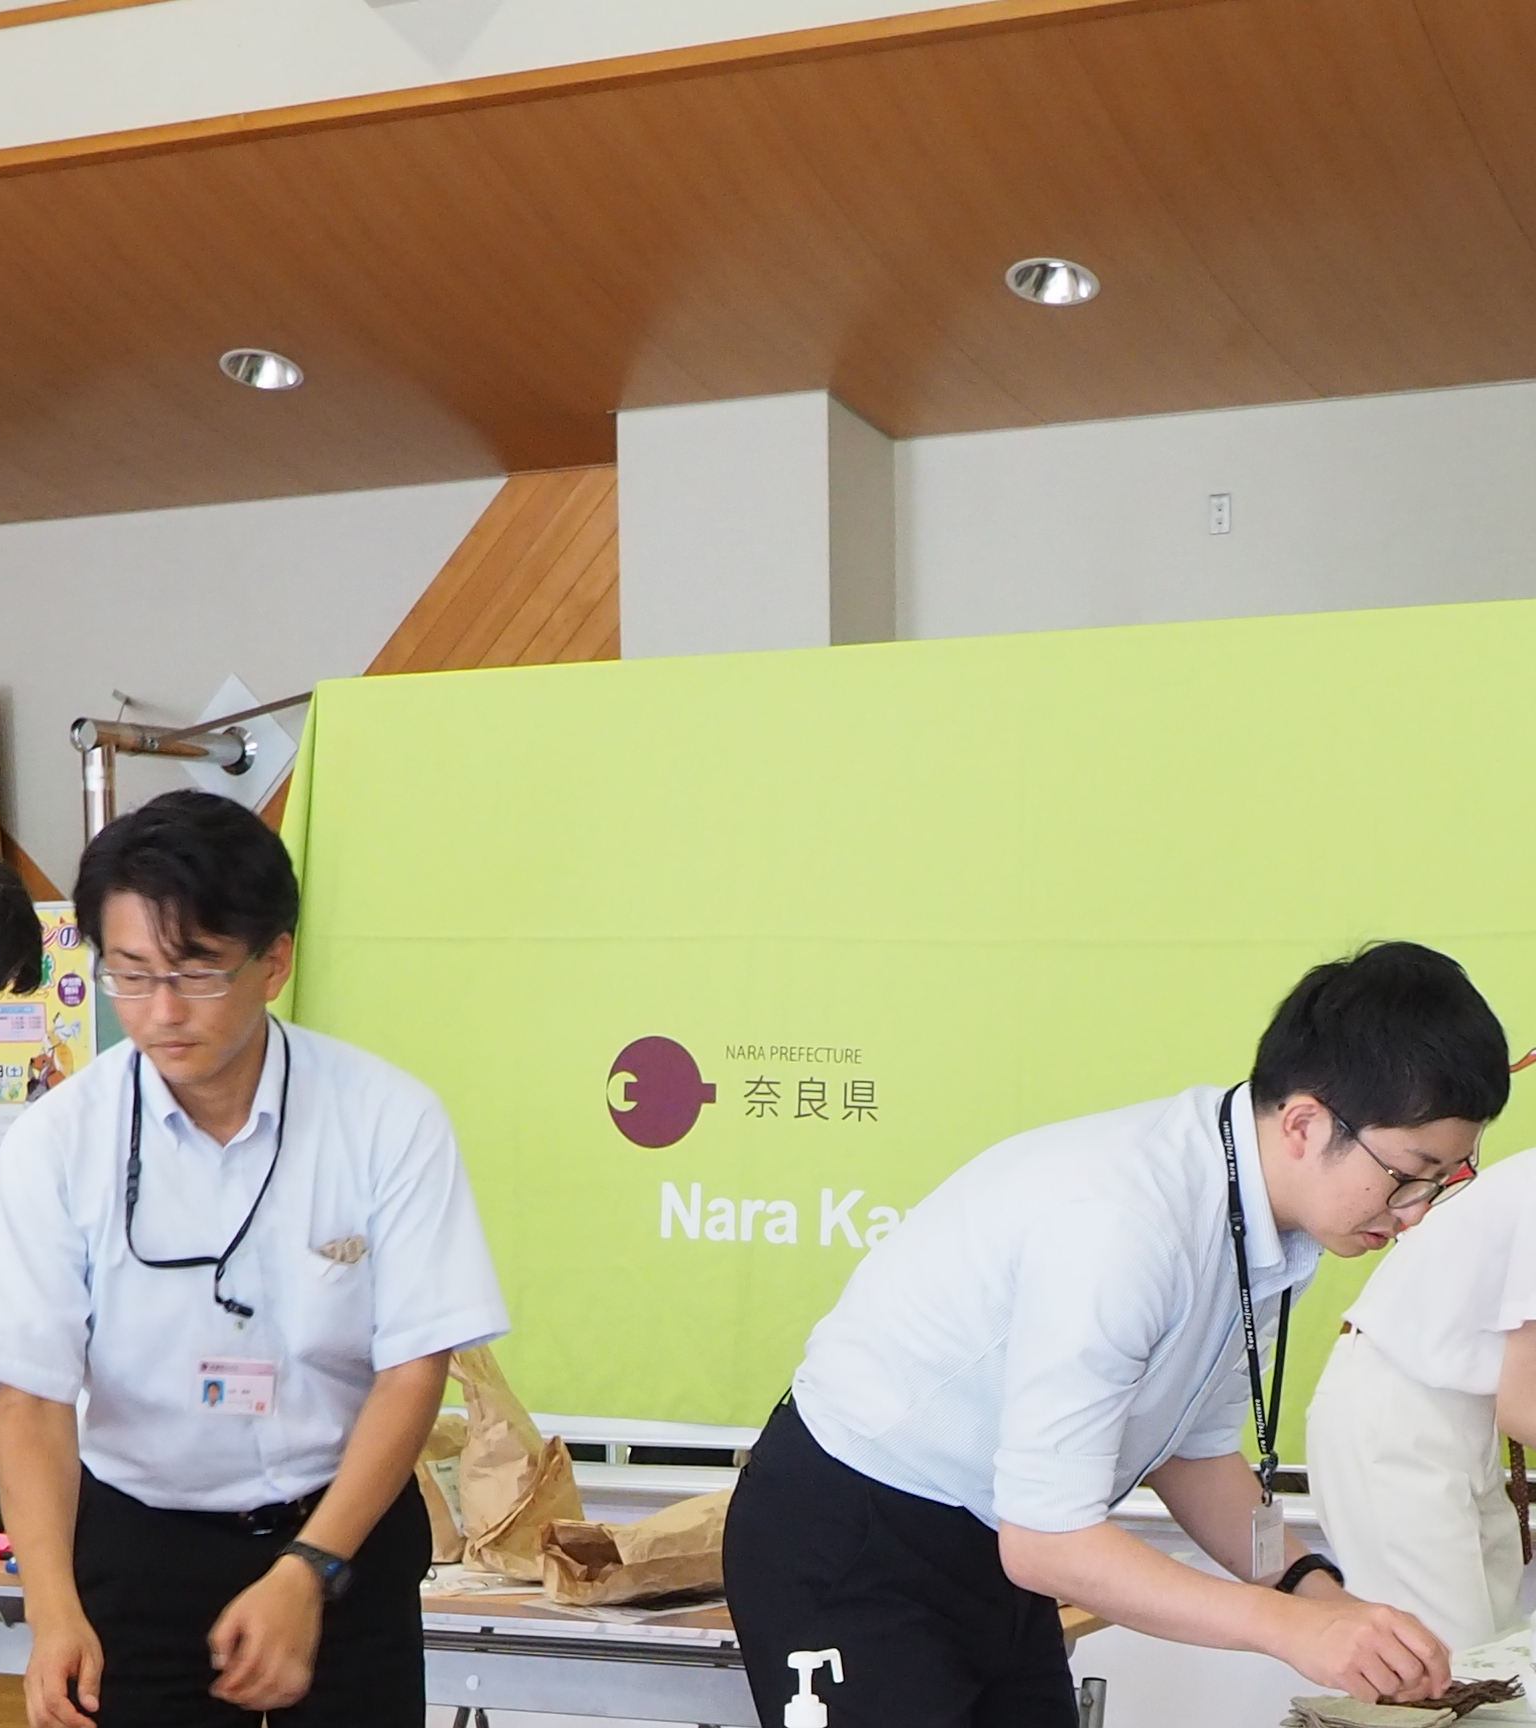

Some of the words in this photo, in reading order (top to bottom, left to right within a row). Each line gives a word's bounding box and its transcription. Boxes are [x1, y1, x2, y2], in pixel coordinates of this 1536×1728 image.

[725, 1044, 766, 1061] NARA
[770, 1045, 862, 1064] PREFECTURE
[743, 1075, 879, 1122] 奈良県
[660, 1181, 797, 1244] Nara
[819, 1187, 916, 1249] Ka
